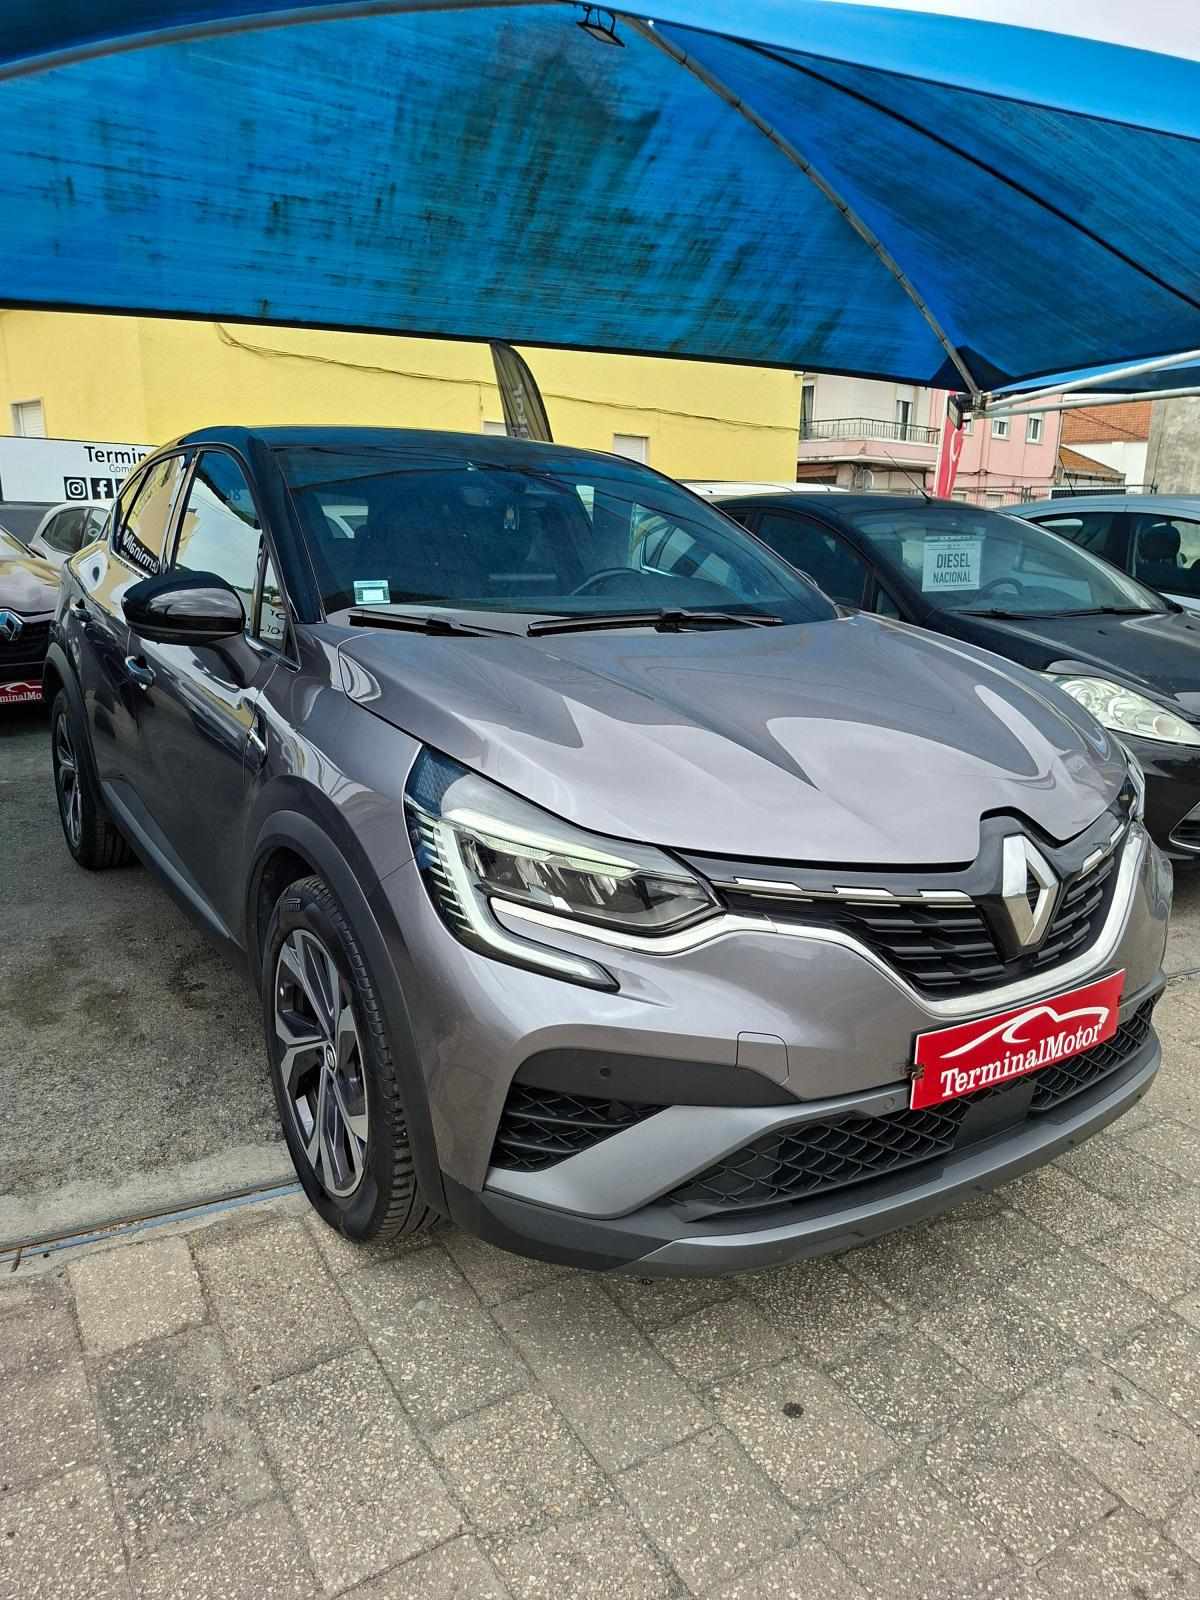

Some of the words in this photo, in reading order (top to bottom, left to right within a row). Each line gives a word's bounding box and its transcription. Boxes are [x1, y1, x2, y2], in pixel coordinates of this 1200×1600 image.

[936, 552, 971, 568] DIESEL
[932, 570, 971, 584] NACIONAL
[940, 1022, 1105, 1097] TerminalMotor
